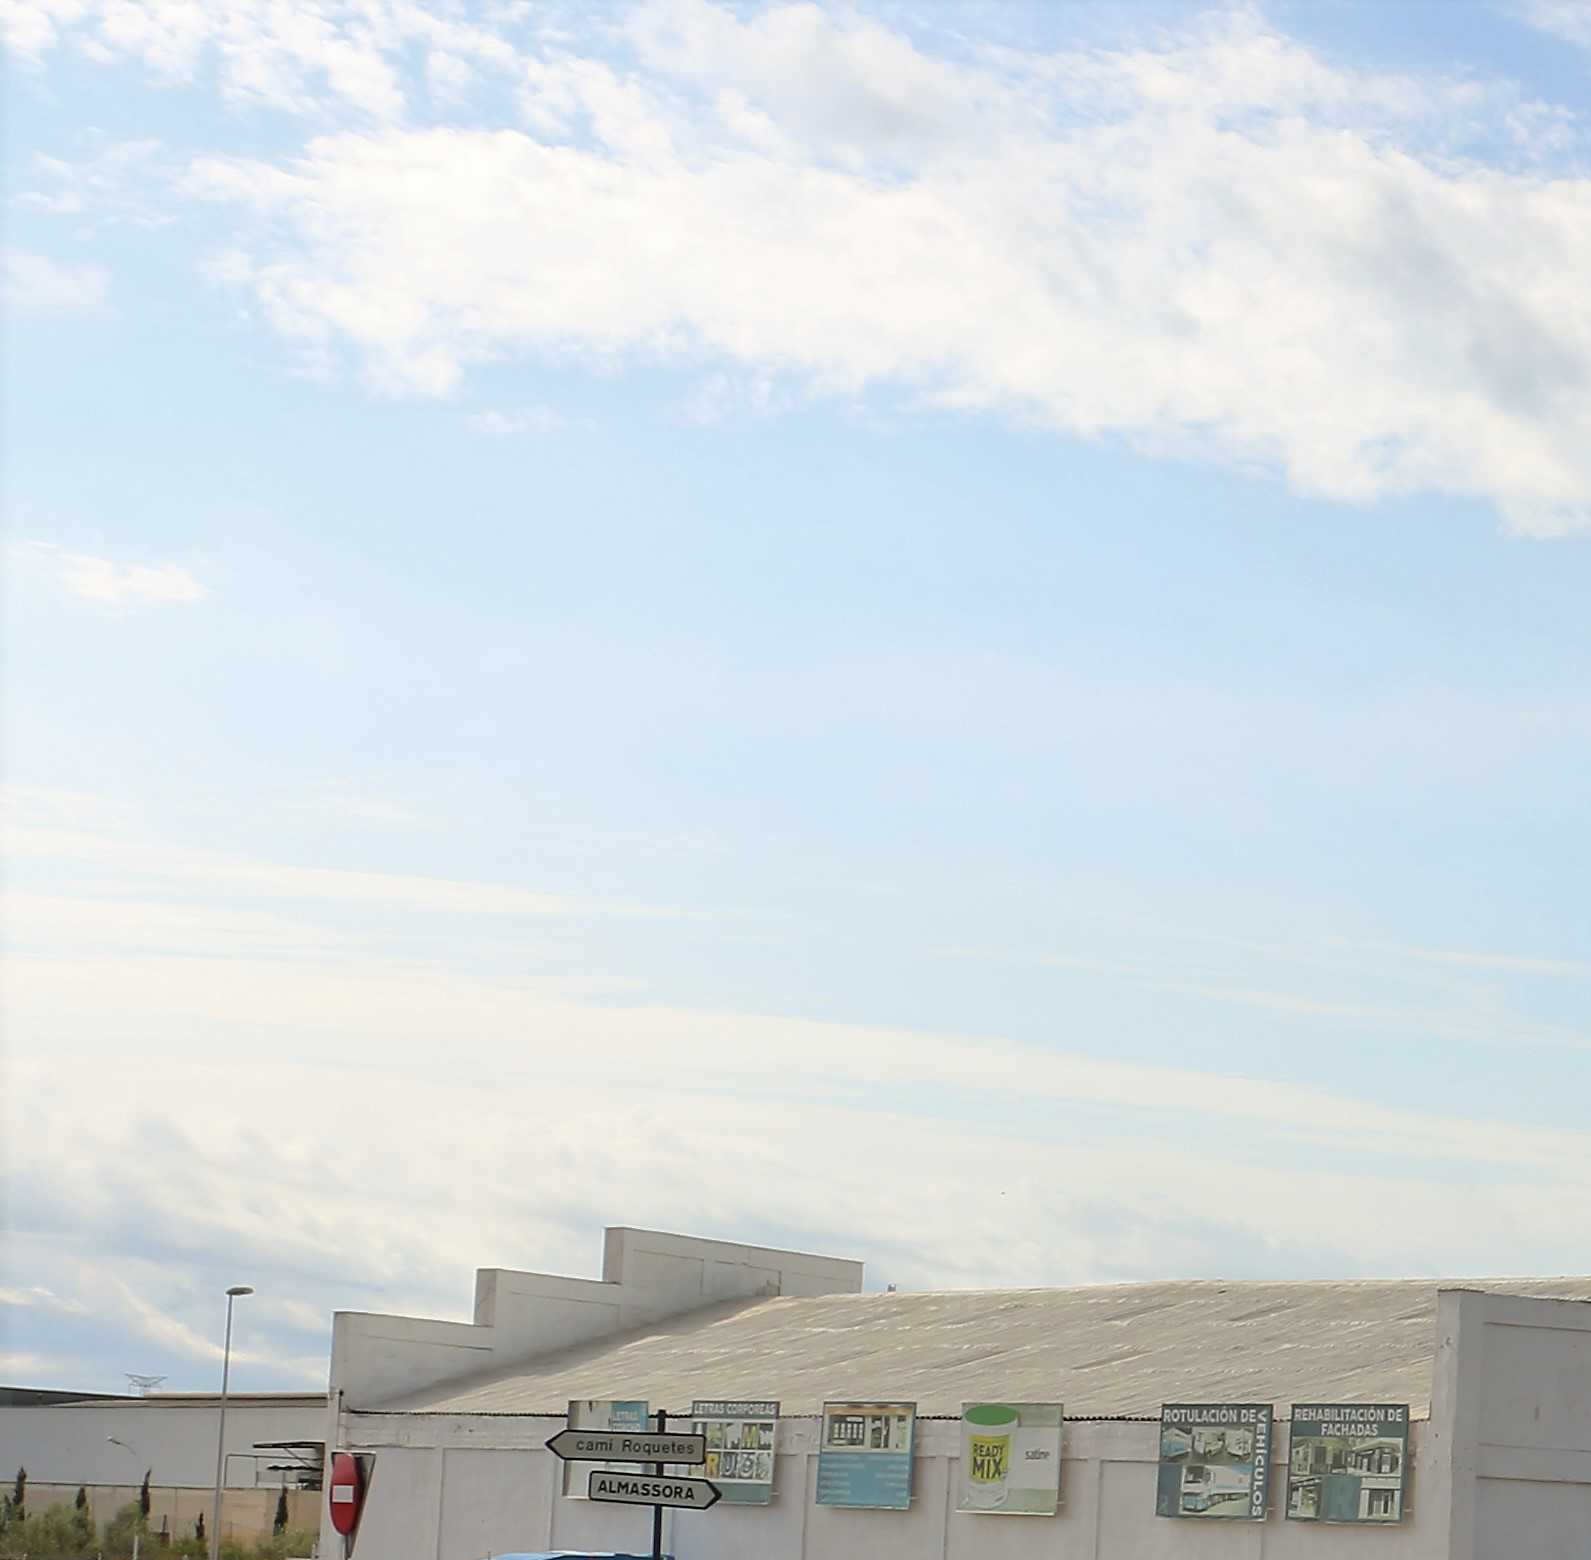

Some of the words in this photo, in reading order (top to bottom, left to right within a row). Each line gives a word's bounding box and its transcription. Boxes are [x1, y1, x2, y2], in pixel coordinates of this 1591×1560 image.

[1163, 1406, 1238, 1424] ROTULACIÓN
[1240, 1408, 1257, 1424] DE
[1294, 1406, 1385, 1422] REHABILITACIÓN
[1387, 1407, 1403, 1422] DE
[1320, 1422, 1378, 1437] FACHADAS
[622, 1439, 695, 1456] Roquetes
[972, 1443, 1005, 1458] READY
[972, 1457, 1002, 1480] MIX
[598, 1479, 695, 1500] ALMASSORA
